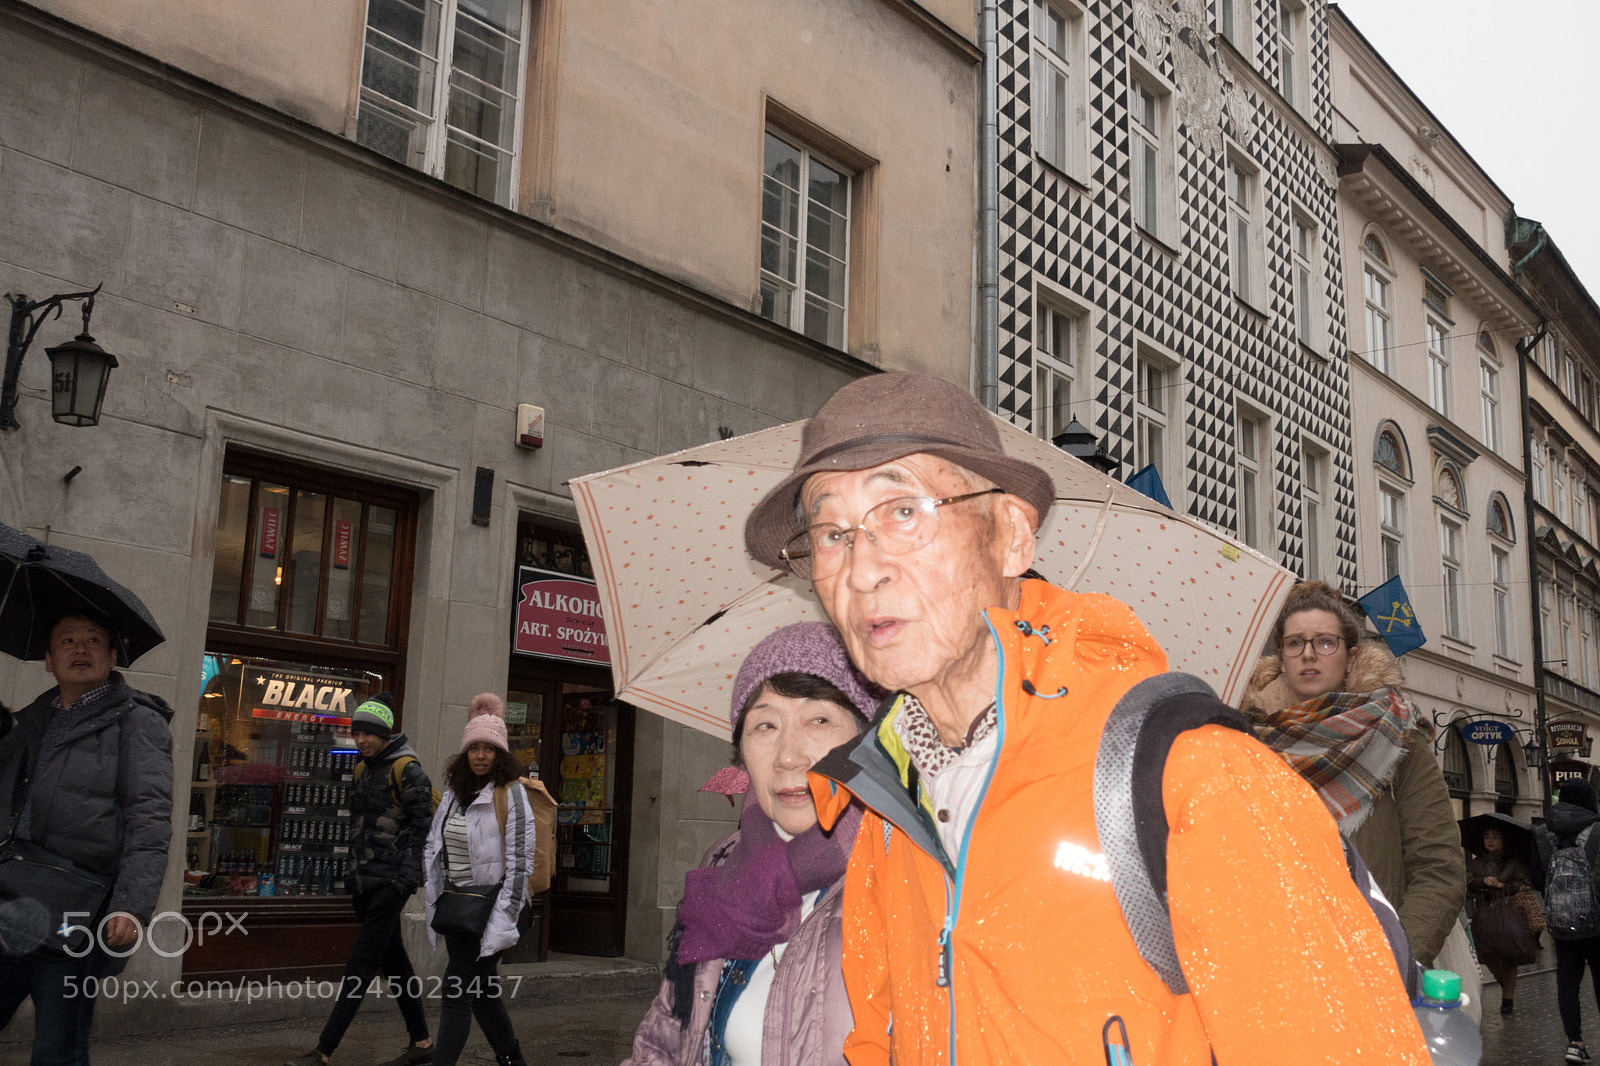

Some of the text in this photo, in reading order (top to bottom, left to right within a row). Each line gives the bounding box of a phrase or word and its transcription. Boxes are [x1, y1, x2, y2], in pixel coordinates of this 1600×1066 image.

[520, 621, 552, 638] ART.
[271, 672, 344, 686] THE ORIGINAL PREMIUM
[262, 680, 353, 713] BLACK
[276, 712, 326, 723] ENERGY
[1471, 731, 1503, 740] OPTYK
